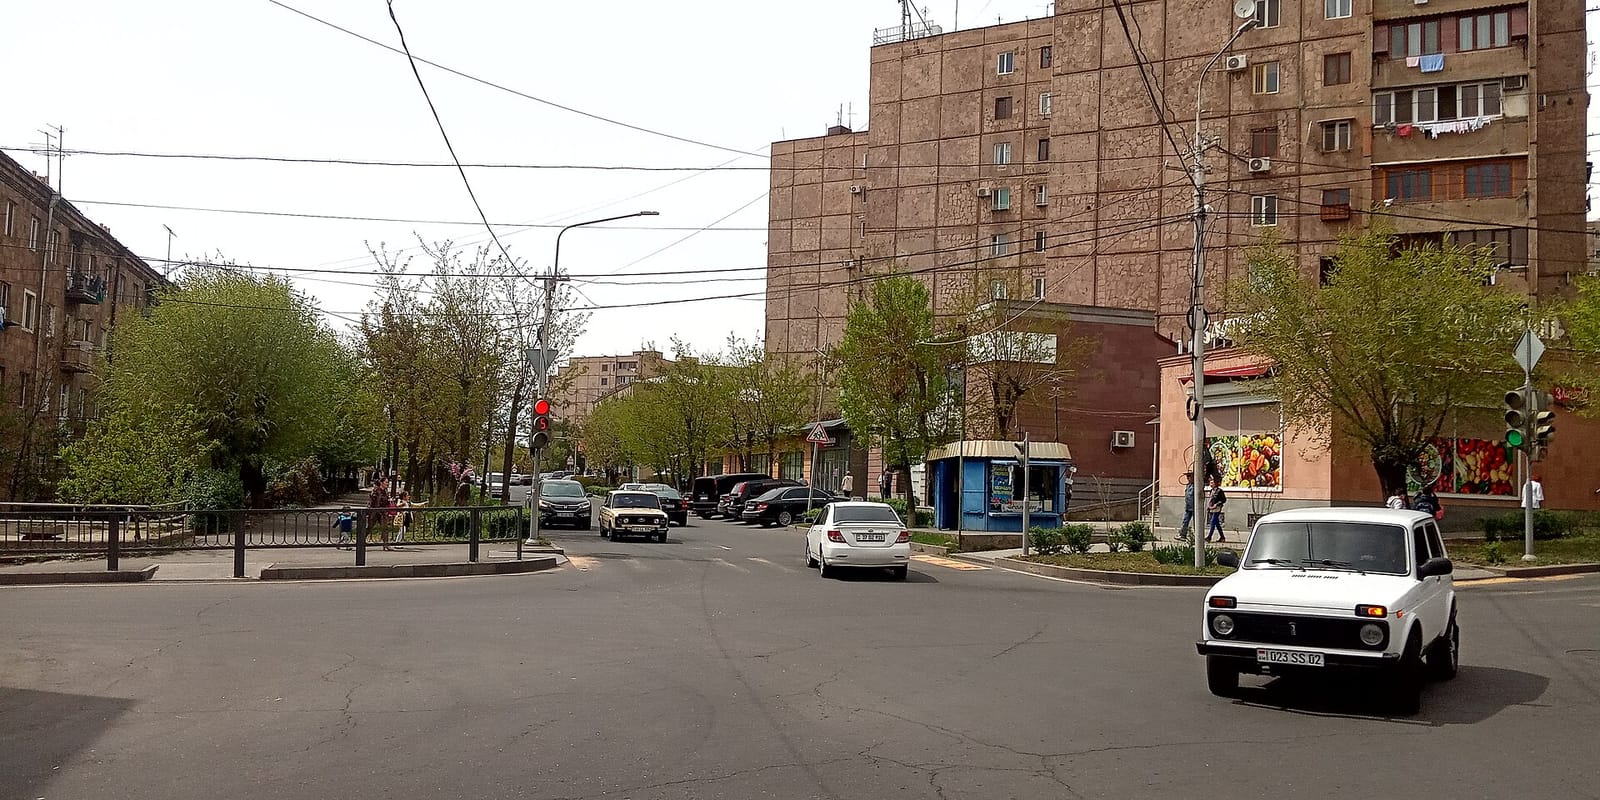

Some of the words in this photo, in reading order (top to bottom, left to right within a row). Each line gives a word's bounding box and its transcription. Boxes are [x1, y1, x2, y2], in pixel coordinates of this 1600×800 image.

[540, 417, 546, 430] 5
[1270, 651, 1289, 662] 023
[1291, 652, 1306, 664] SS
[1308, 654, 1321, 665] 02
